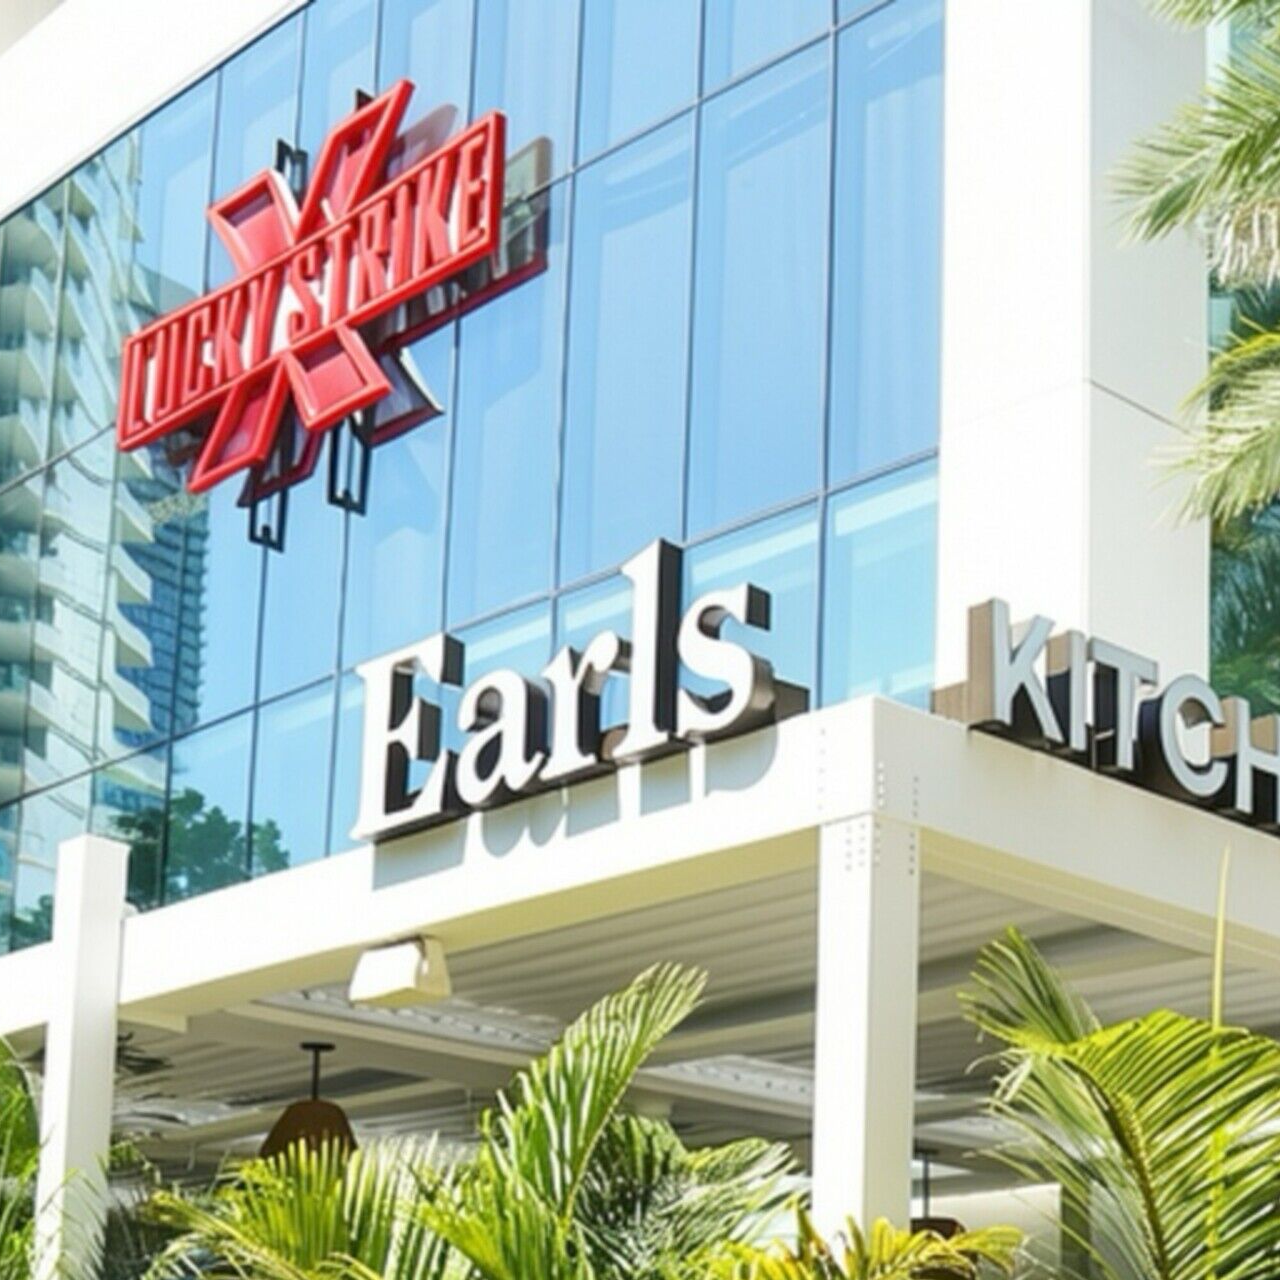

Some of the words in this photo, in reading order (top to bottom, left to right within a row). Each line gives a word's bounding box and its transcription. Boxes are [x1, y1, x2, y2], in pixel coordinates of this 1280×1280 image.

[126, 266, 285, 432] LUCKY
[286, 133, 488, 344] STRIKE
[350, 538, 762, 842] Earls
